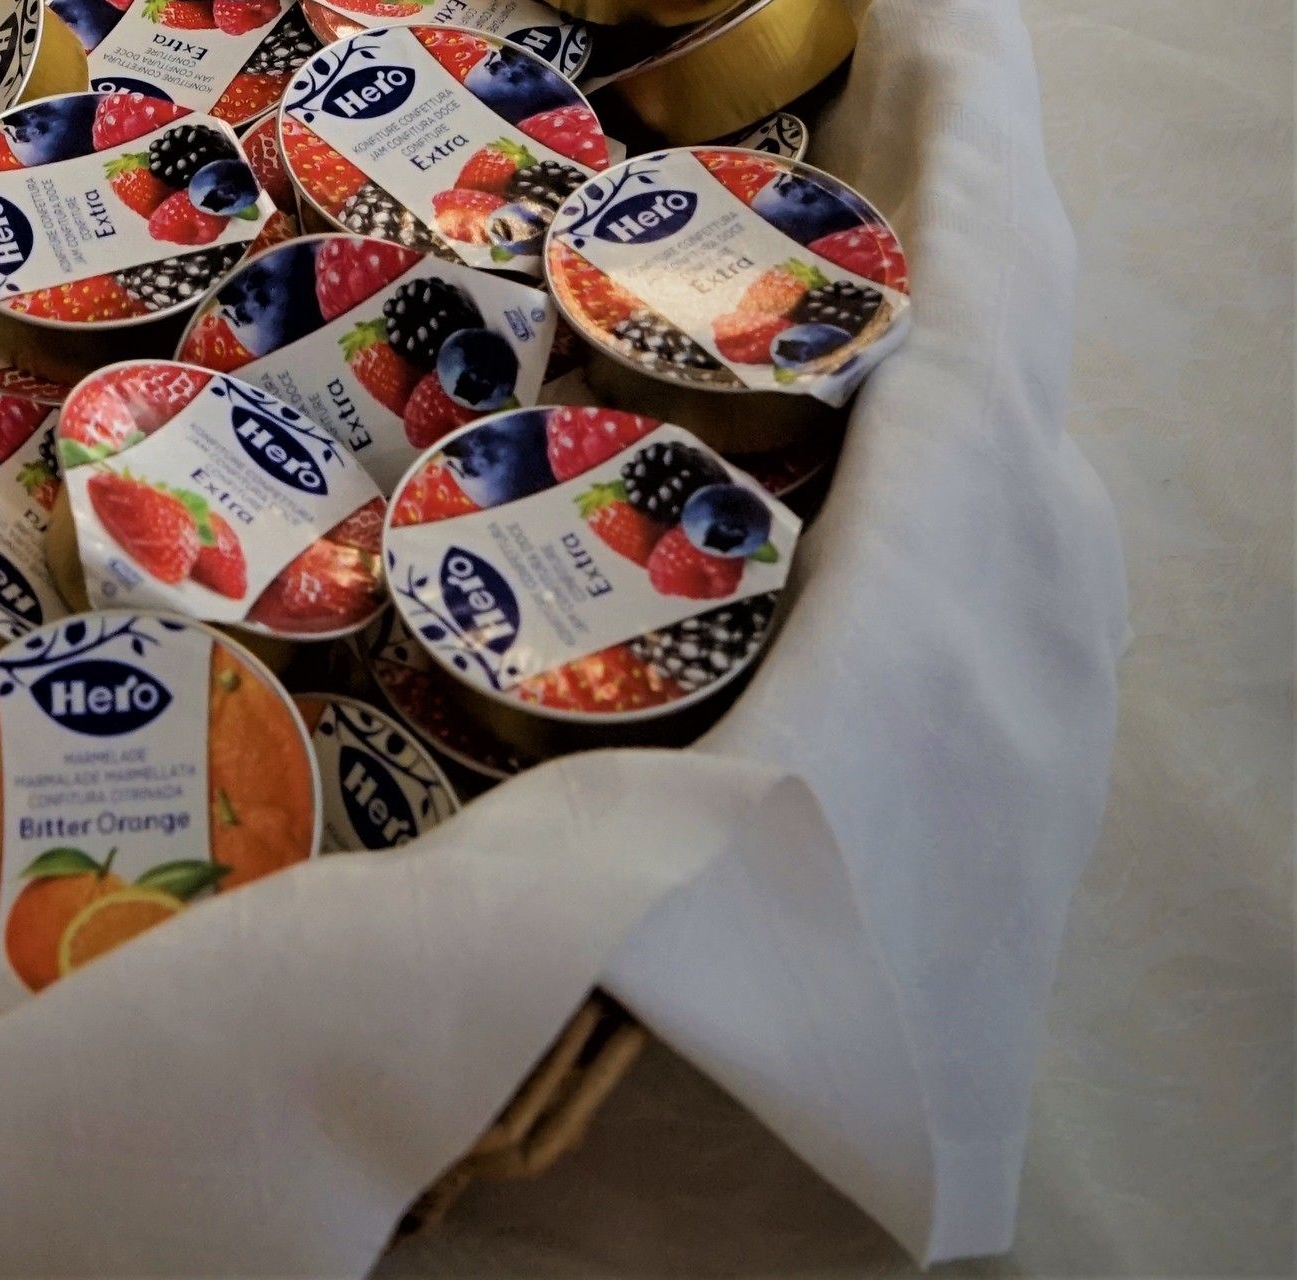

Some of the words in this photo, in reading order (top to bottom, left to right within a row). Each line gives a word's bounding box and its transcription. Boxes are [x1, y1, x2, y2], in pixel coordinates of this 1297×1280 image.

[102, 52, 162, 79] CONFETTURA
[113, 46, 141, 62] DOCE
[141, 57, 195, 78] CONFITURA
[144, 47, 198, 69] CONFITURE
[152, 33, 209, 61] Extra
[163, 73, 214, 94] KONFITURE
[193, 73, 215, 83] JAM
[333, 67, 408, 119] Hero
[351, 121, 401, 155] KONFITURE
[398, 87, 454, 127] CONFETTURA
[369, 144, 388, 162] JAM
[386, 116, 436, 151] CONFITURA
[433, 99, 462, 121] DOCE
[409, 133, 470, 172] Extra
[84, 189, 117, 239] Extra
[605, 193, 689, 243] Hero
[689, 255, 755, 295] Extra
[325, 377, 373, 452] Extra
[236, 418, 321, 489] Hero
[190, 467, 254, 525] Extra
[561, 531, 614, 598] Extra
[447, 552, 516, 651] Hero
[50, 675, 160, 717] Hero
[342, 761, 412, 842] Her
[19, 815, 92, 840] Bitter
[96, 810, 192, 836] Orange
